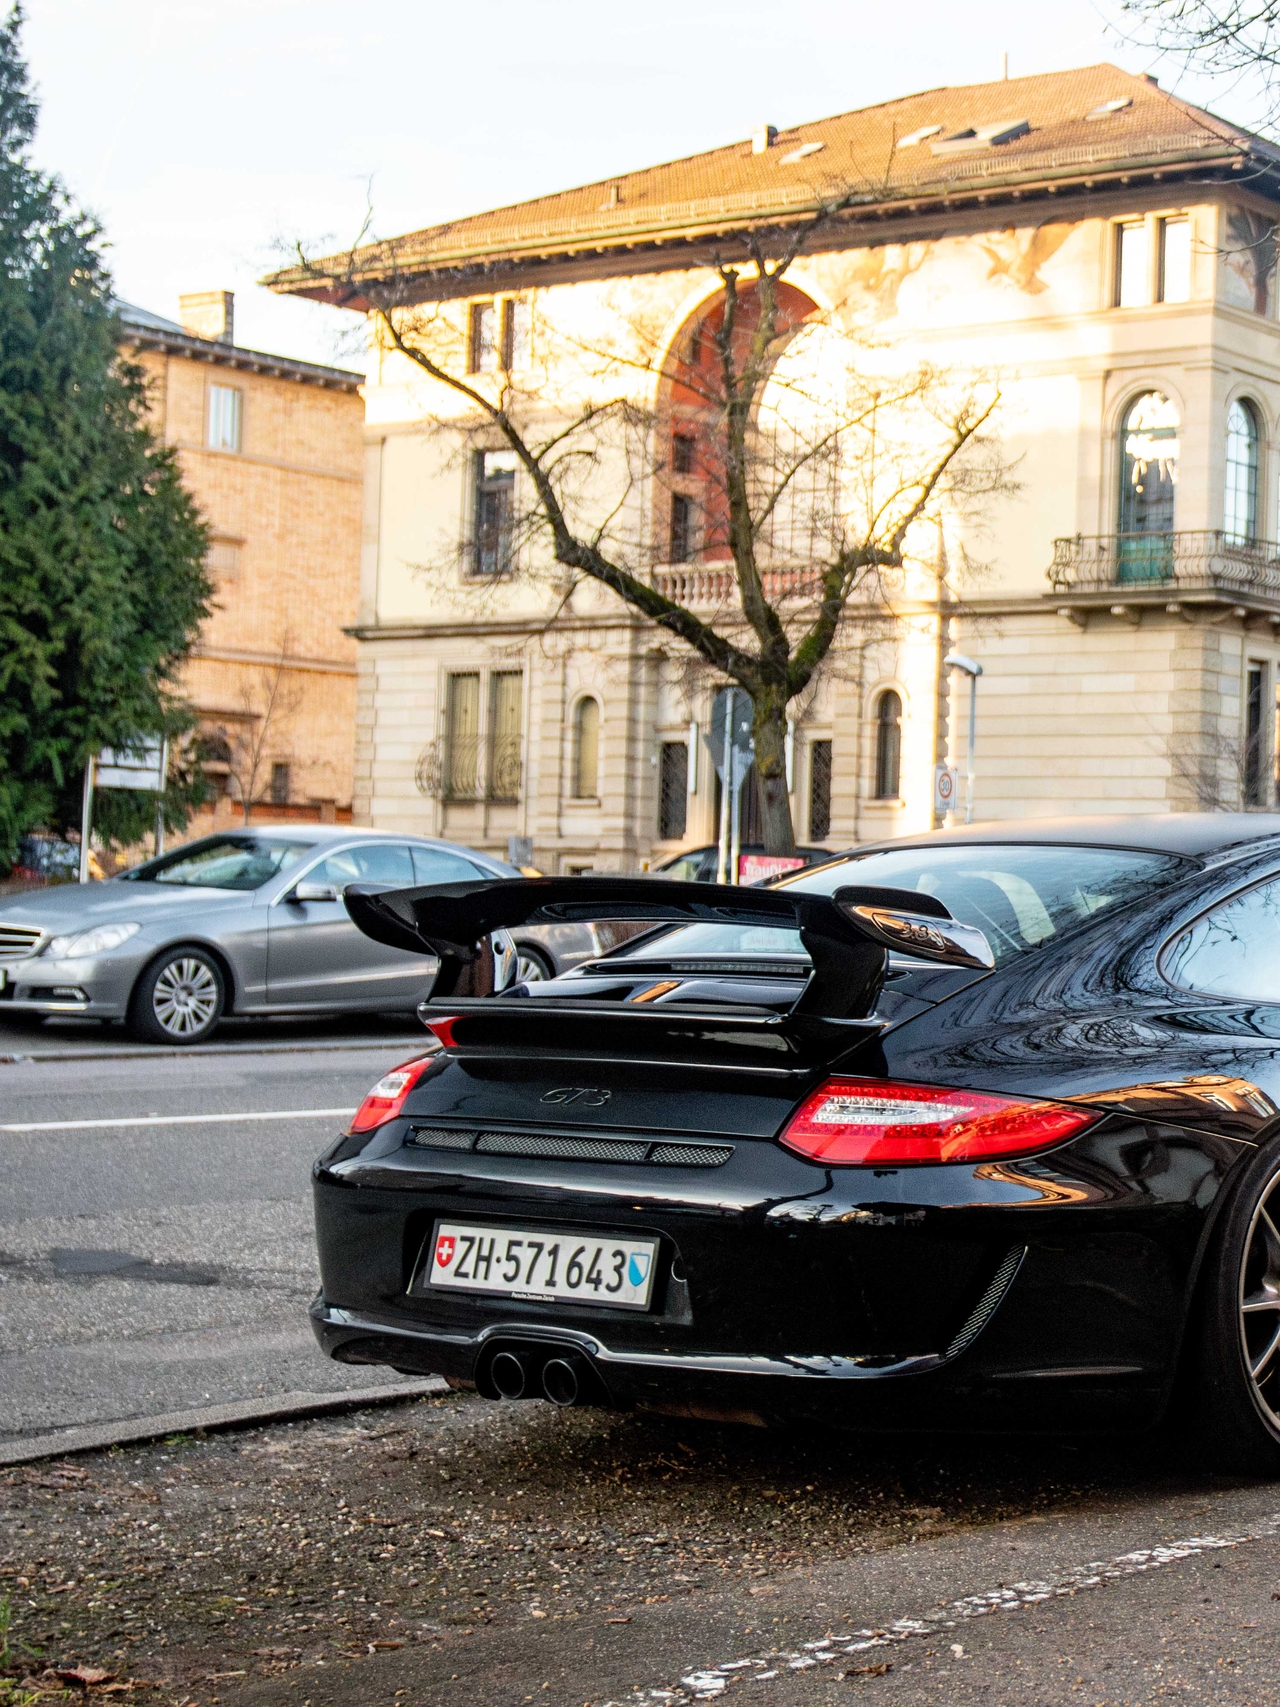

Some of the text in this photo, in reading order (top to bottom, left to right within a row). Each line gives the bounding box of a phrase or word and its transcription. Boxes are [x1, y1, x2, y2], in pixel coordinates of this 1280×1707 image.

[940, 778, 950, 792] 30
[899, 921, 929, 940] 3.8
[539, 1087, 612, 1106] GT3
